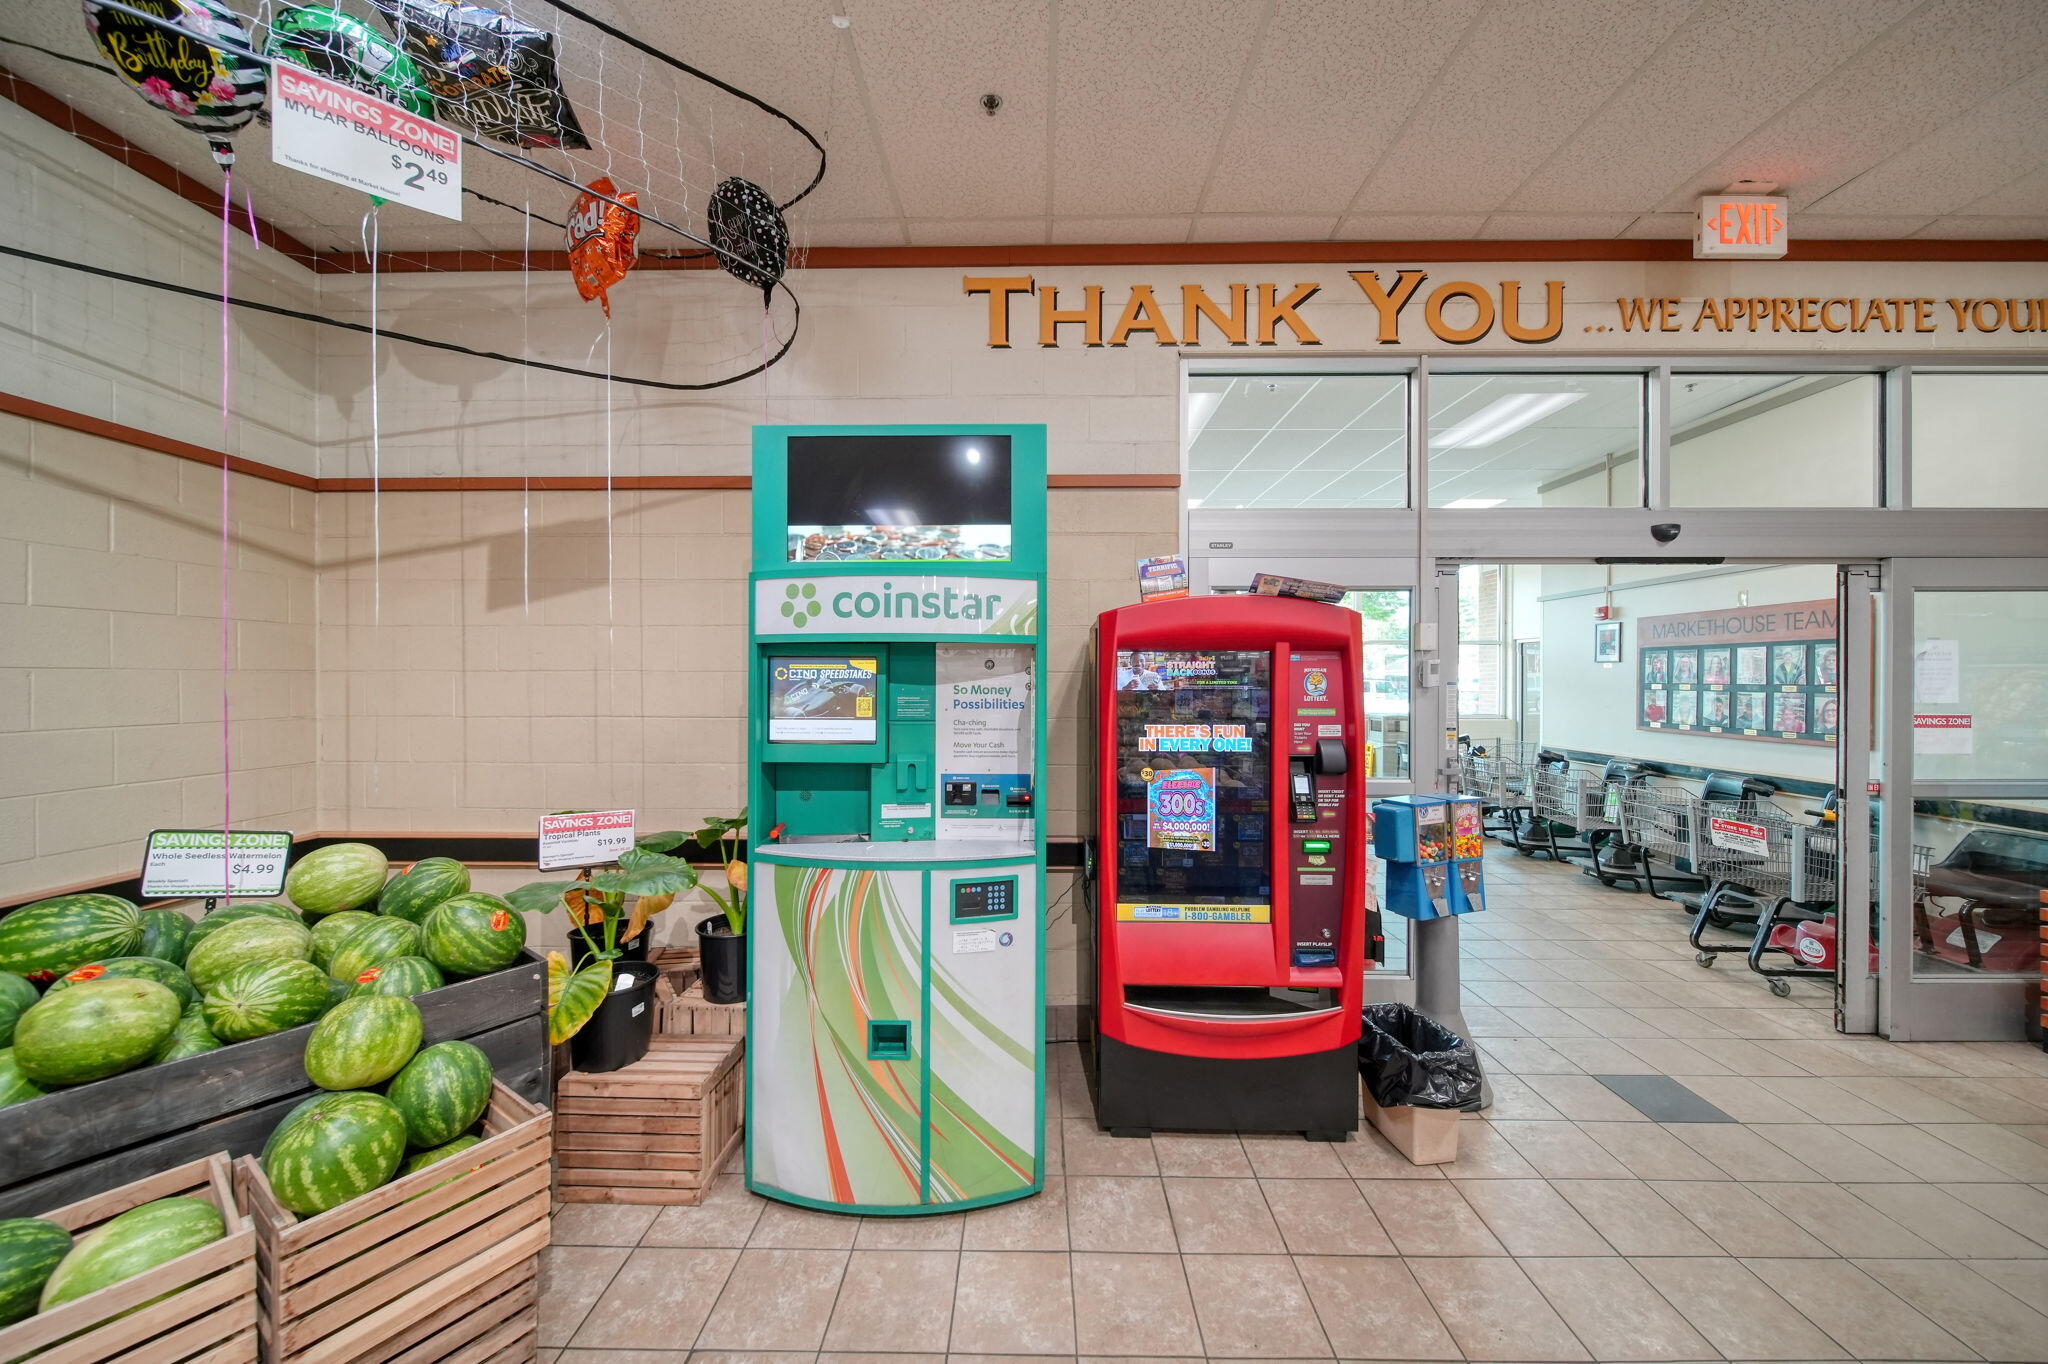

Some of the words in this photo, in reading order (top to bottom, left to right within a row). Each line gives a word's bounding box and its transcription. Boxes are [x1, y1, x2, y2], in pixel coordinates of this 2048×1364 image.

[108, 31, 213, 88] Birthday
[281, 75, 383, 125] SAVINGS
[389, 115, 456, 155] ZONE!
[285, 97, 349, 129] MYLAR
[353, 122, 446, 165] BALLOONS
[285, 154, 309, 168] Thanks
[320, 167, 350, 181] shopping
[358, 179, 379, 190] Market
[567, 200, 606, 249] rad!
[1719, 203, 1777, 245] EXIT
[963, 274, 1324, 349] THANK
[1348, 269, 1566, 345] YOU
[1692, 297, 1938, 333] APPRECIATE
[1946, 297, 2048, 333] YOU
[832, 582, 1002, 620] coinstar
[1652, 613, 1776, 640] MARKETHOUSE
[1167, 661, 1216, 669] STRAIGHT
[820, 669, 873, 679] SPEEDSTAKES
[953, 684, 967, 695] So
[971, 684, 1012, 697] Money
[953, 699, 1025, 710] Possibilities
[953, 719, 987, 727] Cha-ching
[1145, 725, 1211, 738] THERE'S
[1213, 725, 1246, 738] FUN
[1139, 738, 1157, 752] IN
[1159, 738, 1213, 752] EVERY
[1213, 738, 1252, 752] ONE!
[1141, 770, 1153, 778] $30
[545, 817, 593, 830] SAVINGS
[597, 814, 631, 826] ZONE!
[1162, 821, 1210, 832] $4,000,000!
[156, 834, 231, 846] SAVINGS
[234, 834, 287, 846] ZONE!
[544, 831, 575, 841] Tropical
[597, 837, 627, 846] $19.99
[152, 852, 182, 860] Whole
[185, 852, 226, 860] Seedless
[232, 863, 274, 874] $4.99
[1185, 912, 1251, 921] 1-800-GAMBLER
